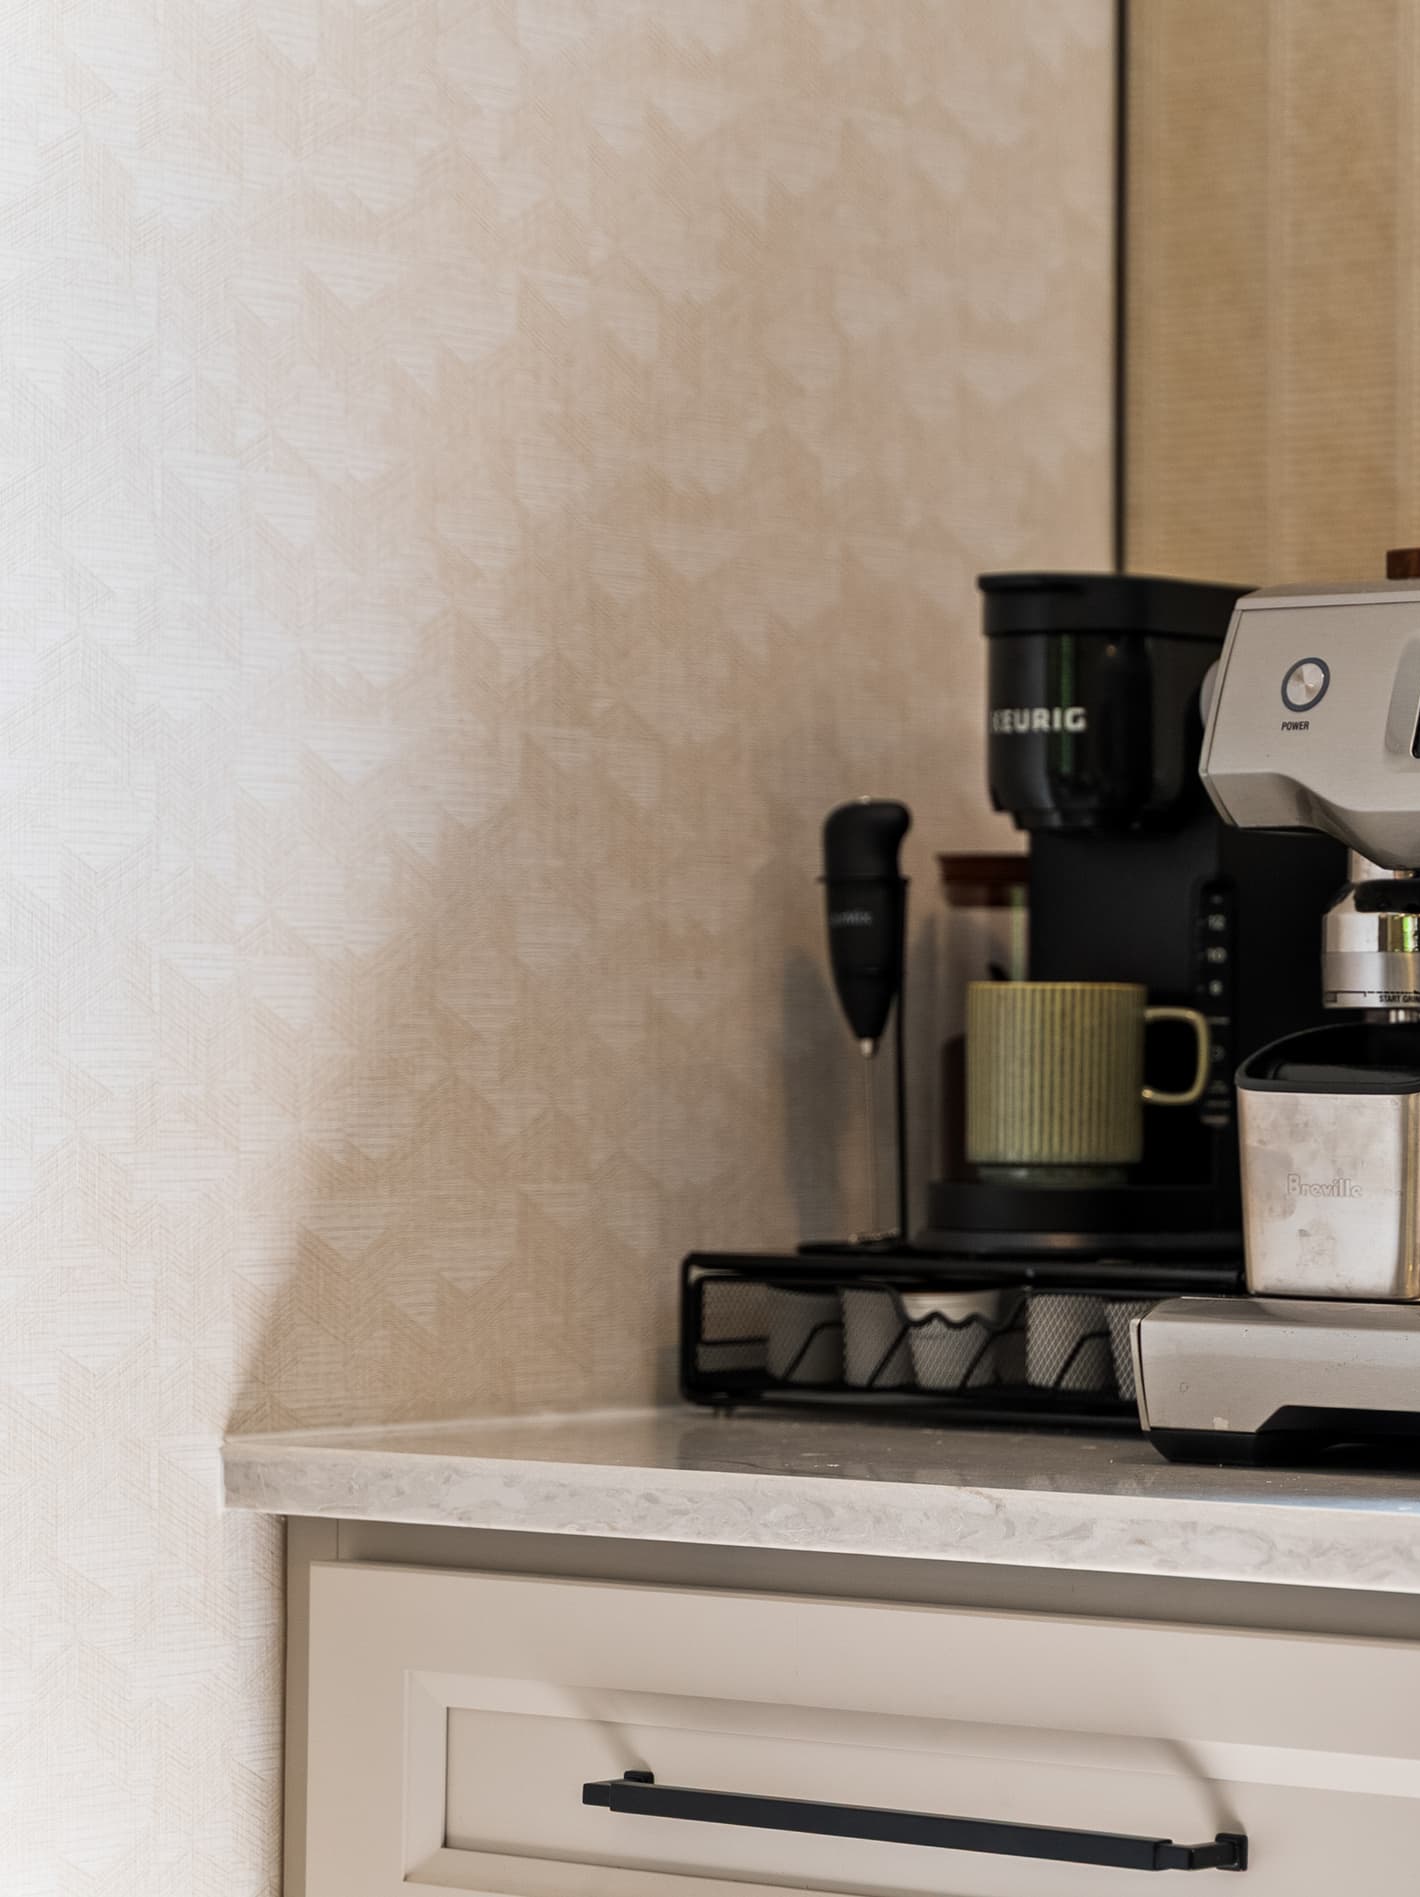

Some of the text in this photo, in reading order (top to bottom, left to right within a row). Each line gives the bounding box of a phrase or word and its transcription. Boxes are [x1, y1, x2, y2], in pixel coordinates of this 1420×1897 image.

[1281, 720, 1309, 731] POWER
[1379, 994, 1401, 1003] START
[1285, 1173, 1363, 1198] Breville
